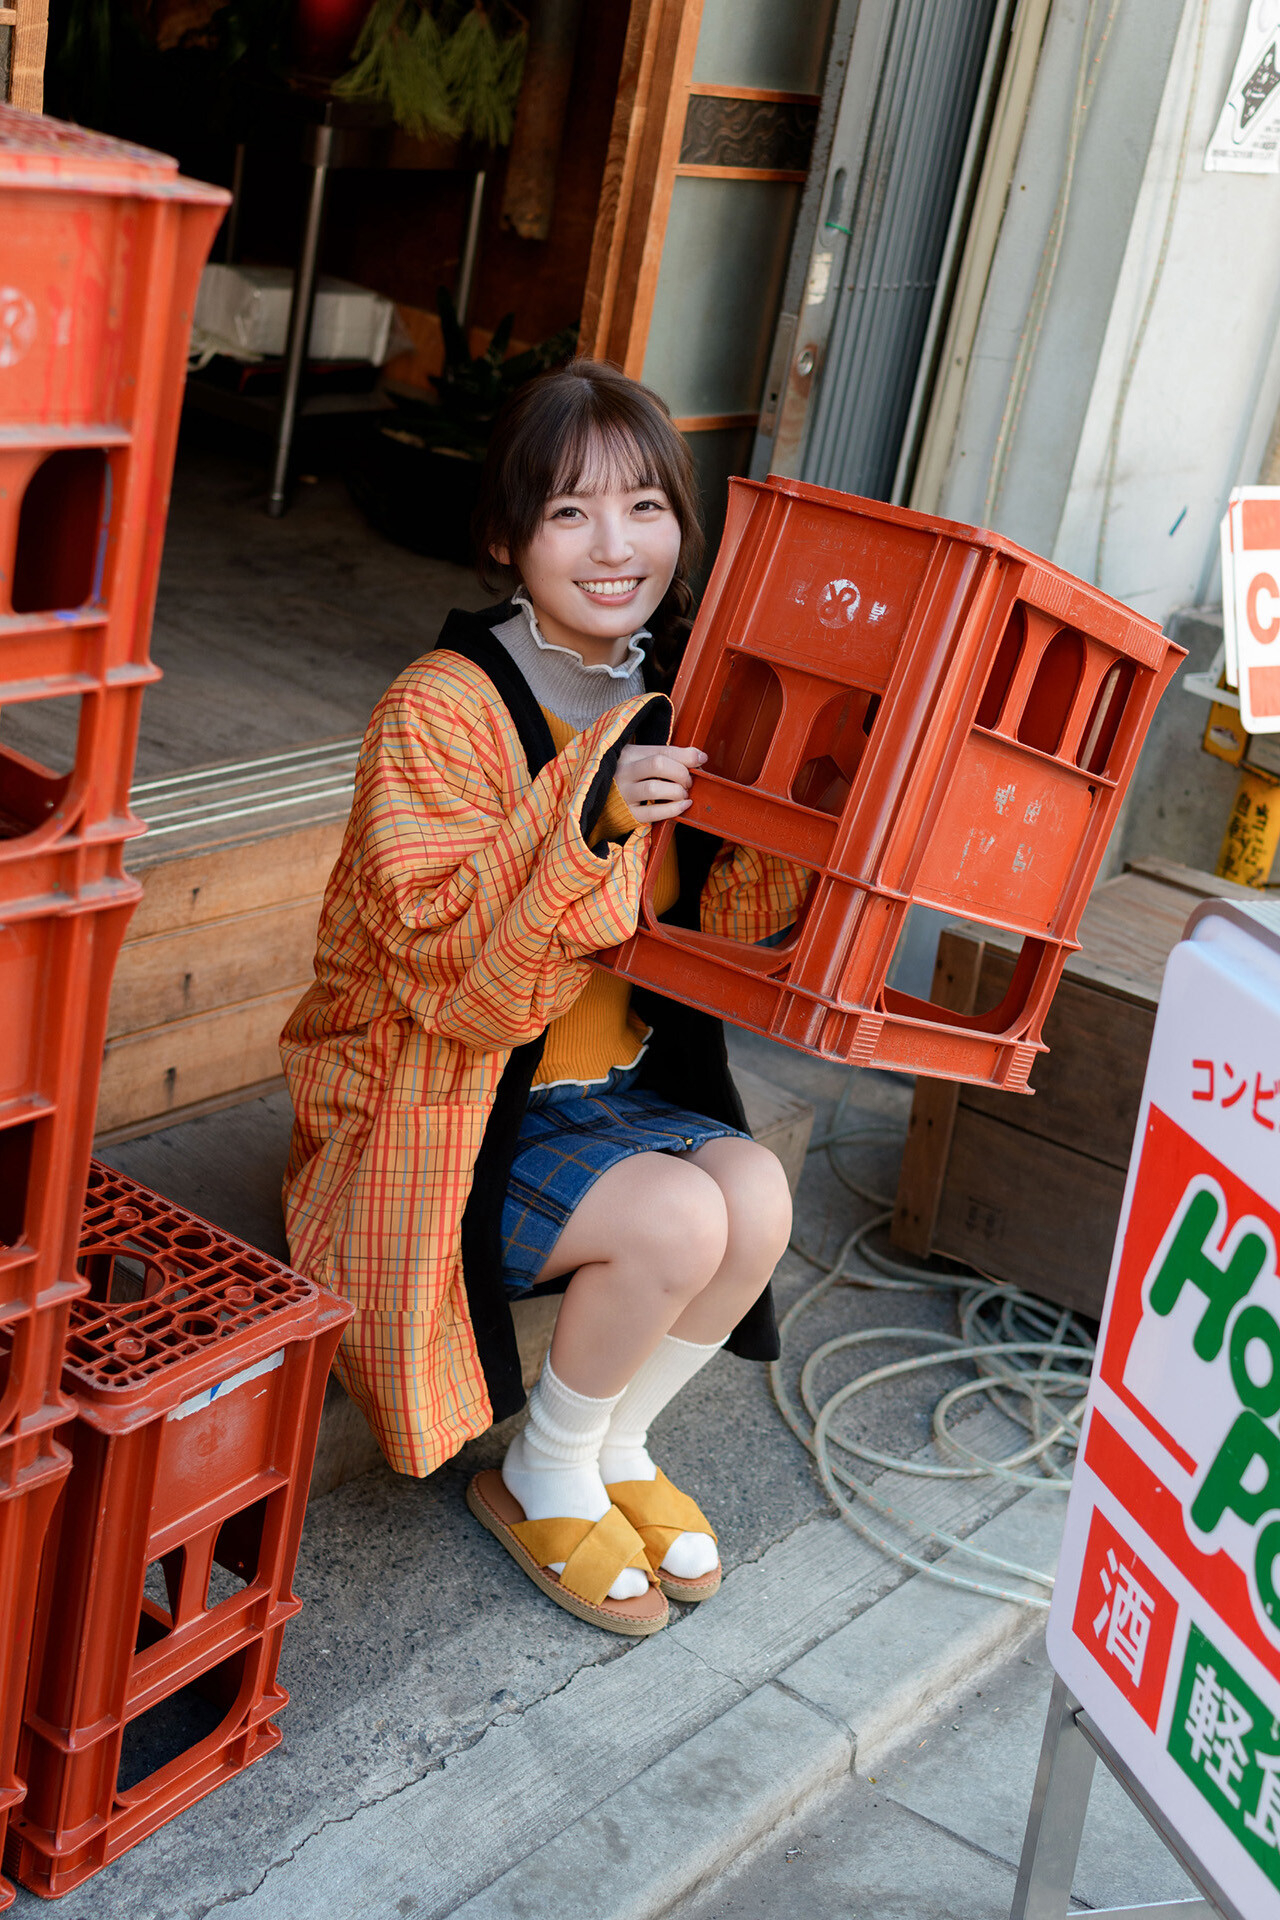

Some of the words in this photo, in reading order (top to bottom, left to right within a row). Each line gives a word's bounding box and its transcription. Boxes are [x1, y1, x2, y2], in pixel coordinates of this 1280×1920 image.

[1192, 1059, 1280, 1131] コンビ
[1149, 1189, 1280, 1418] Ho
[1093, 1548, 1155, 1688] 酒
